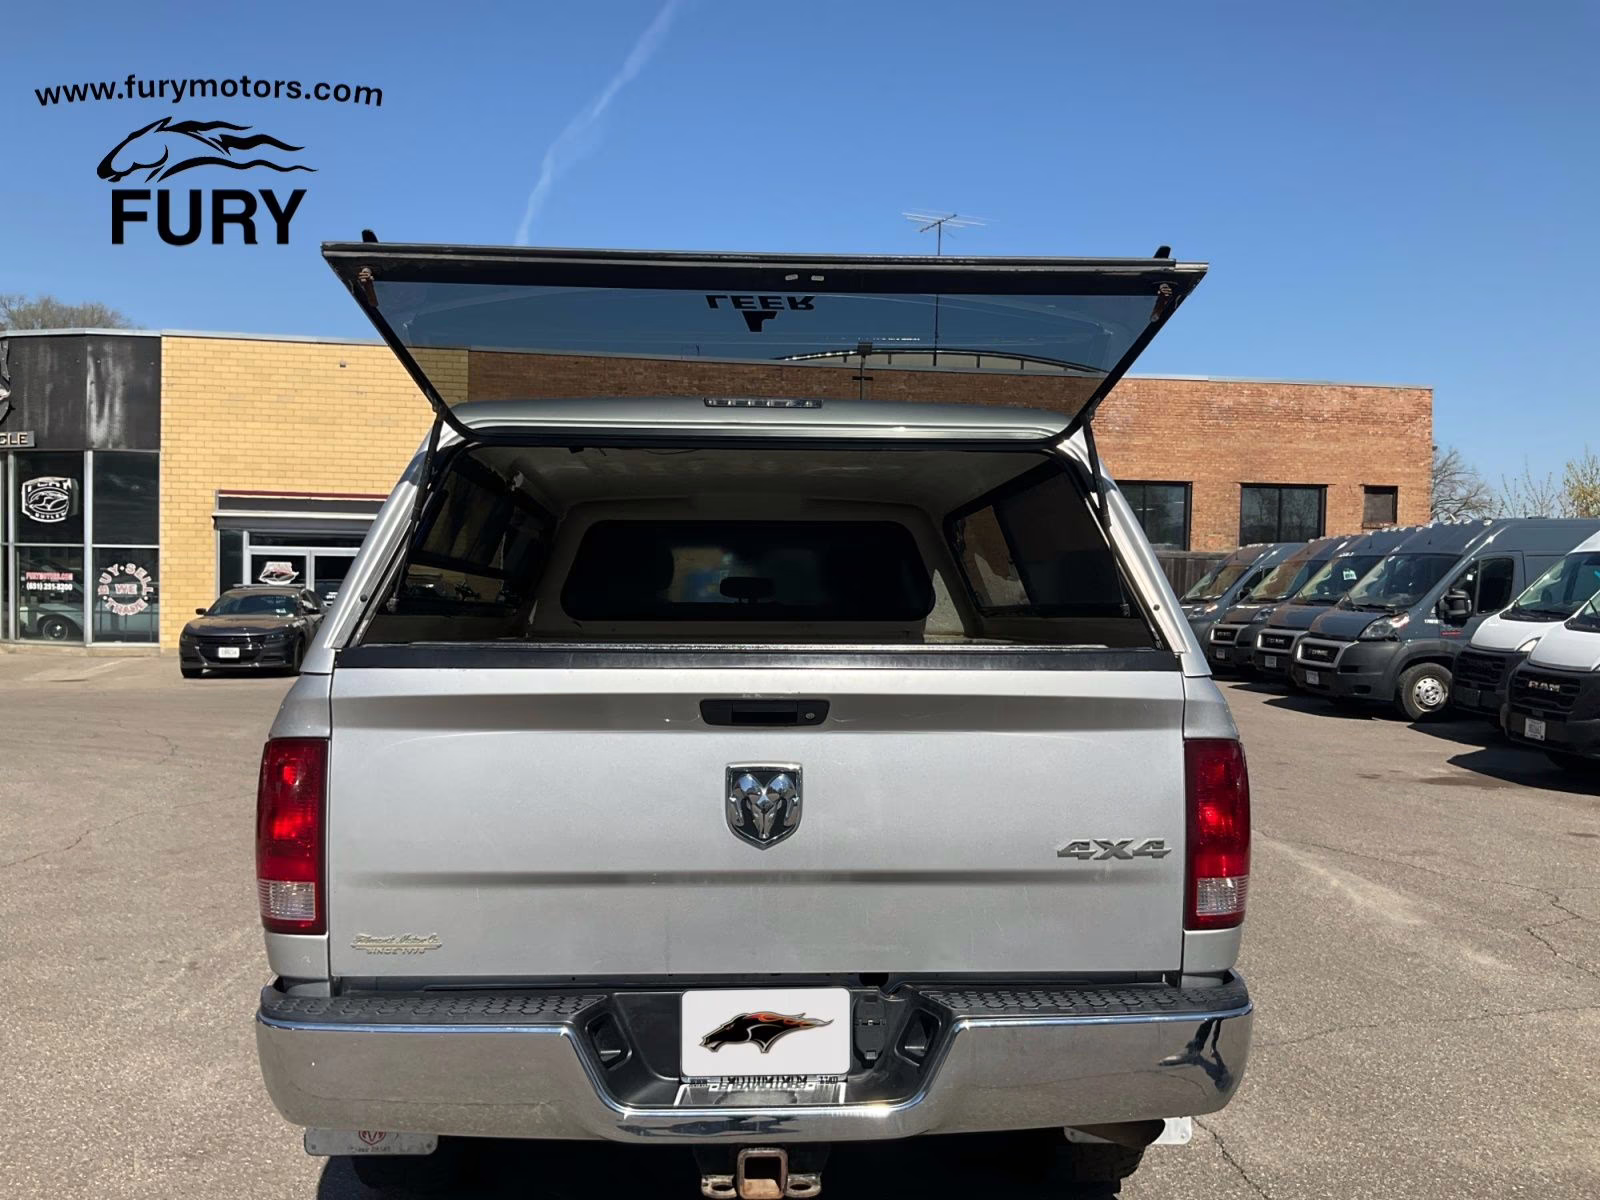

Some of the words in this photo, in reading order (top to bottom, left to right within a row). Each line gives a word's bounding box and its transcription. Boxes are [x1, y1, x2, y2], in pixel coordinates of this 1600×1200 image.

[97, 563, 120, 595] BUY
[114, 583, 138, 595] WE
[125, 562, 154, 596] SELL
[105, 597, 149, 616] TRADE
[1528, 680, 1561, 693] RAM
[1056, 837, 1172, 860] 4X4
